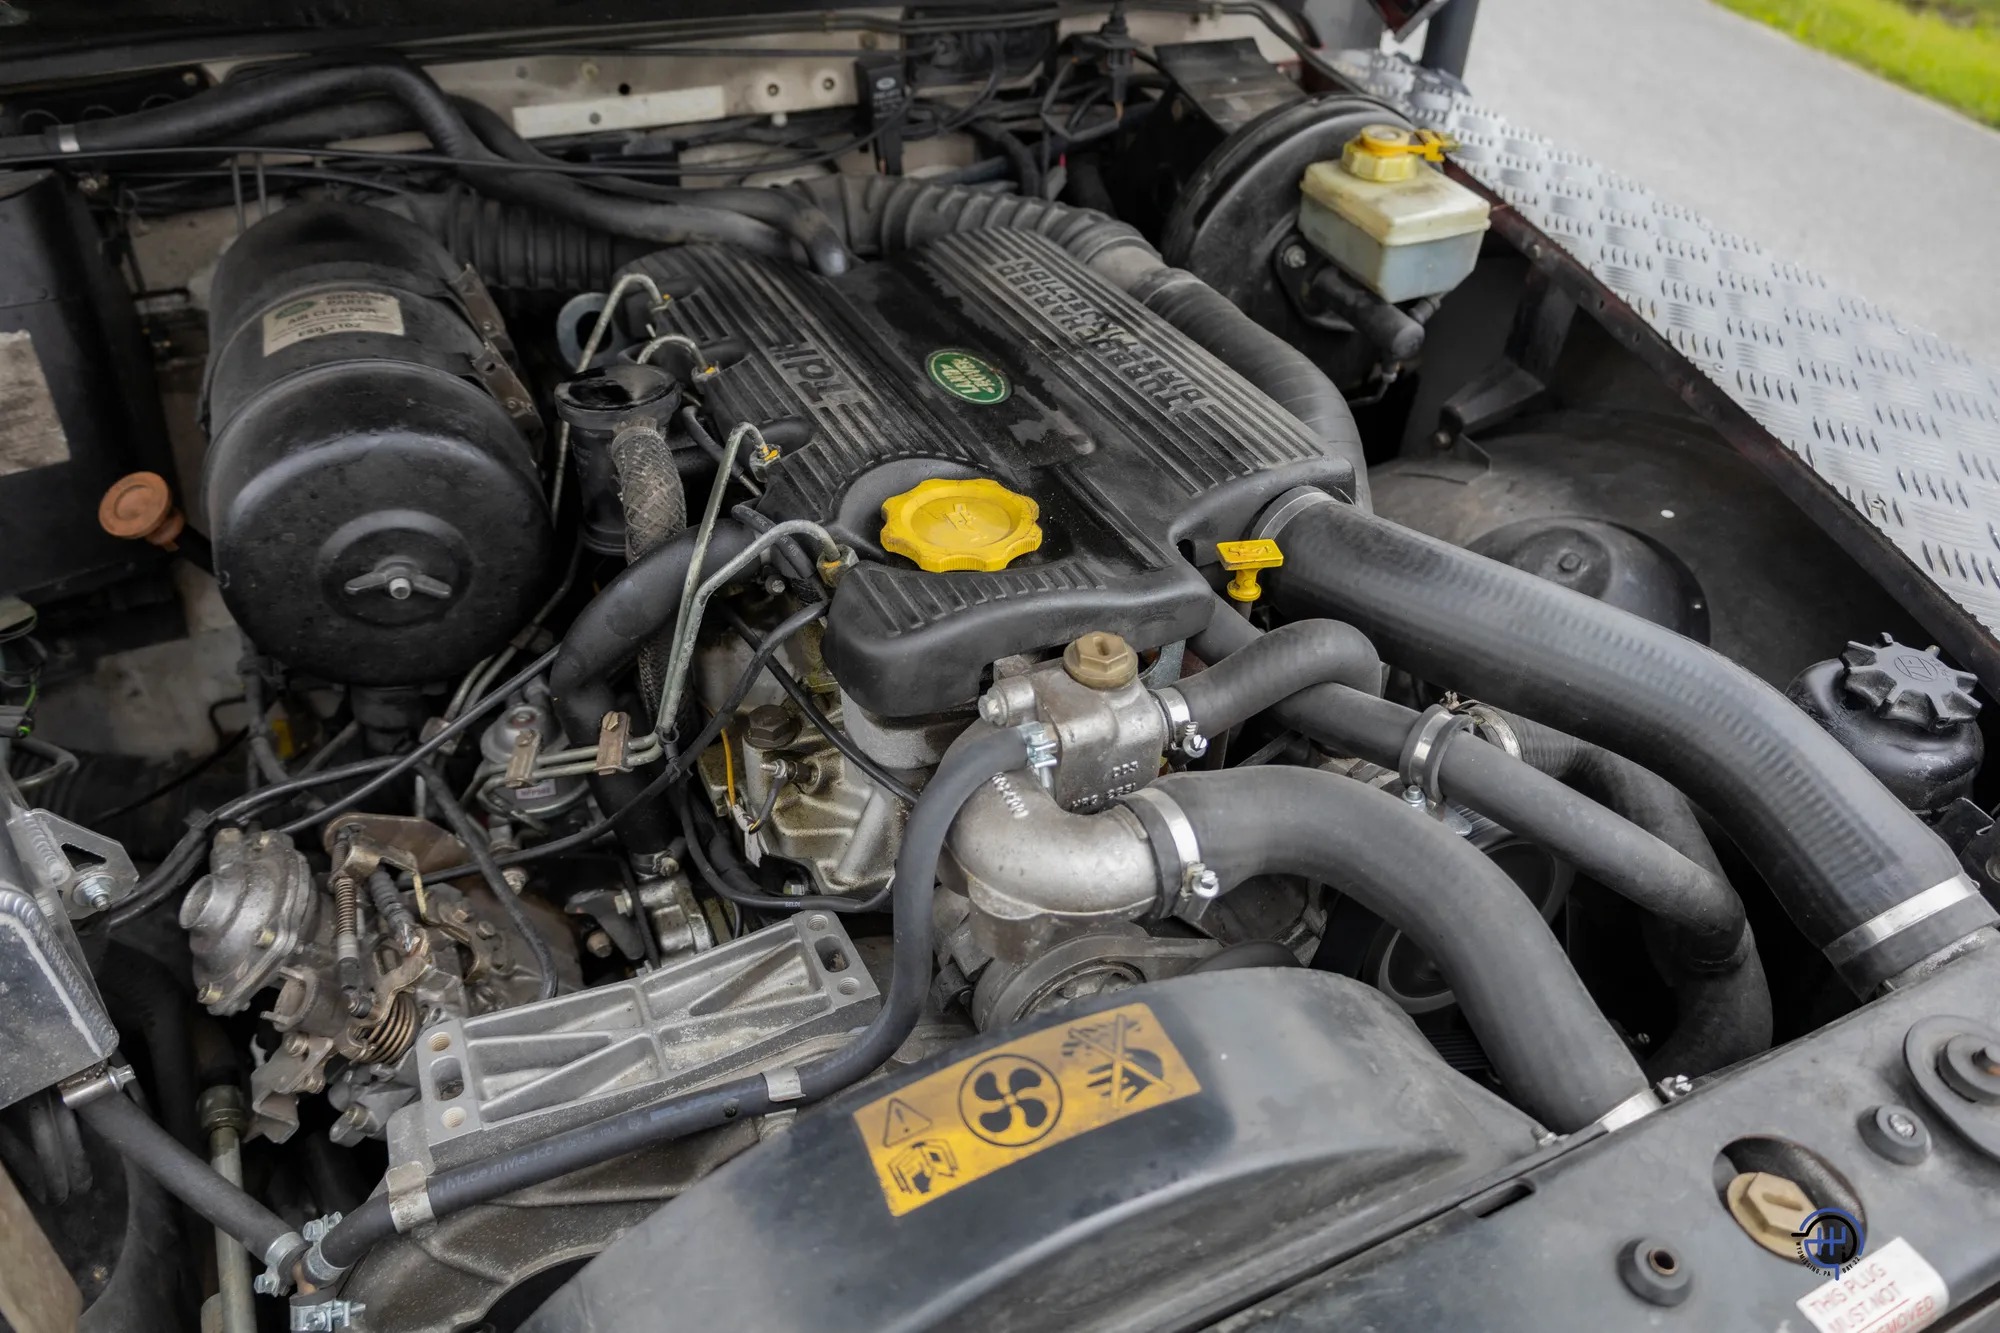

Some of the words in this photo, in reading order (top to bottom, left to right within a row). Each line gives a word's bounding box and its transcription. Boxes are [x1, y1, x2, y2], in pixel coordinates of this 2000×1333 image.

[287, 314, 309, 325] AIR
[313, 307, 377, 317] CLEANER
[997, 263, 1186, 411] TURBOCHARGED
[941, 369, 980, 393] LAND
[951, 358, 995, 387] ROVER
[1118, 339, 1207, 404] DIRECT
[1810, 1287, 1847, 1314] THIS
[1844, 1262, 1886, 1294] PLUG
[1827, 1301, 1870, 1333] MUST
[1869, 1281, 1901, 1308] NOT
